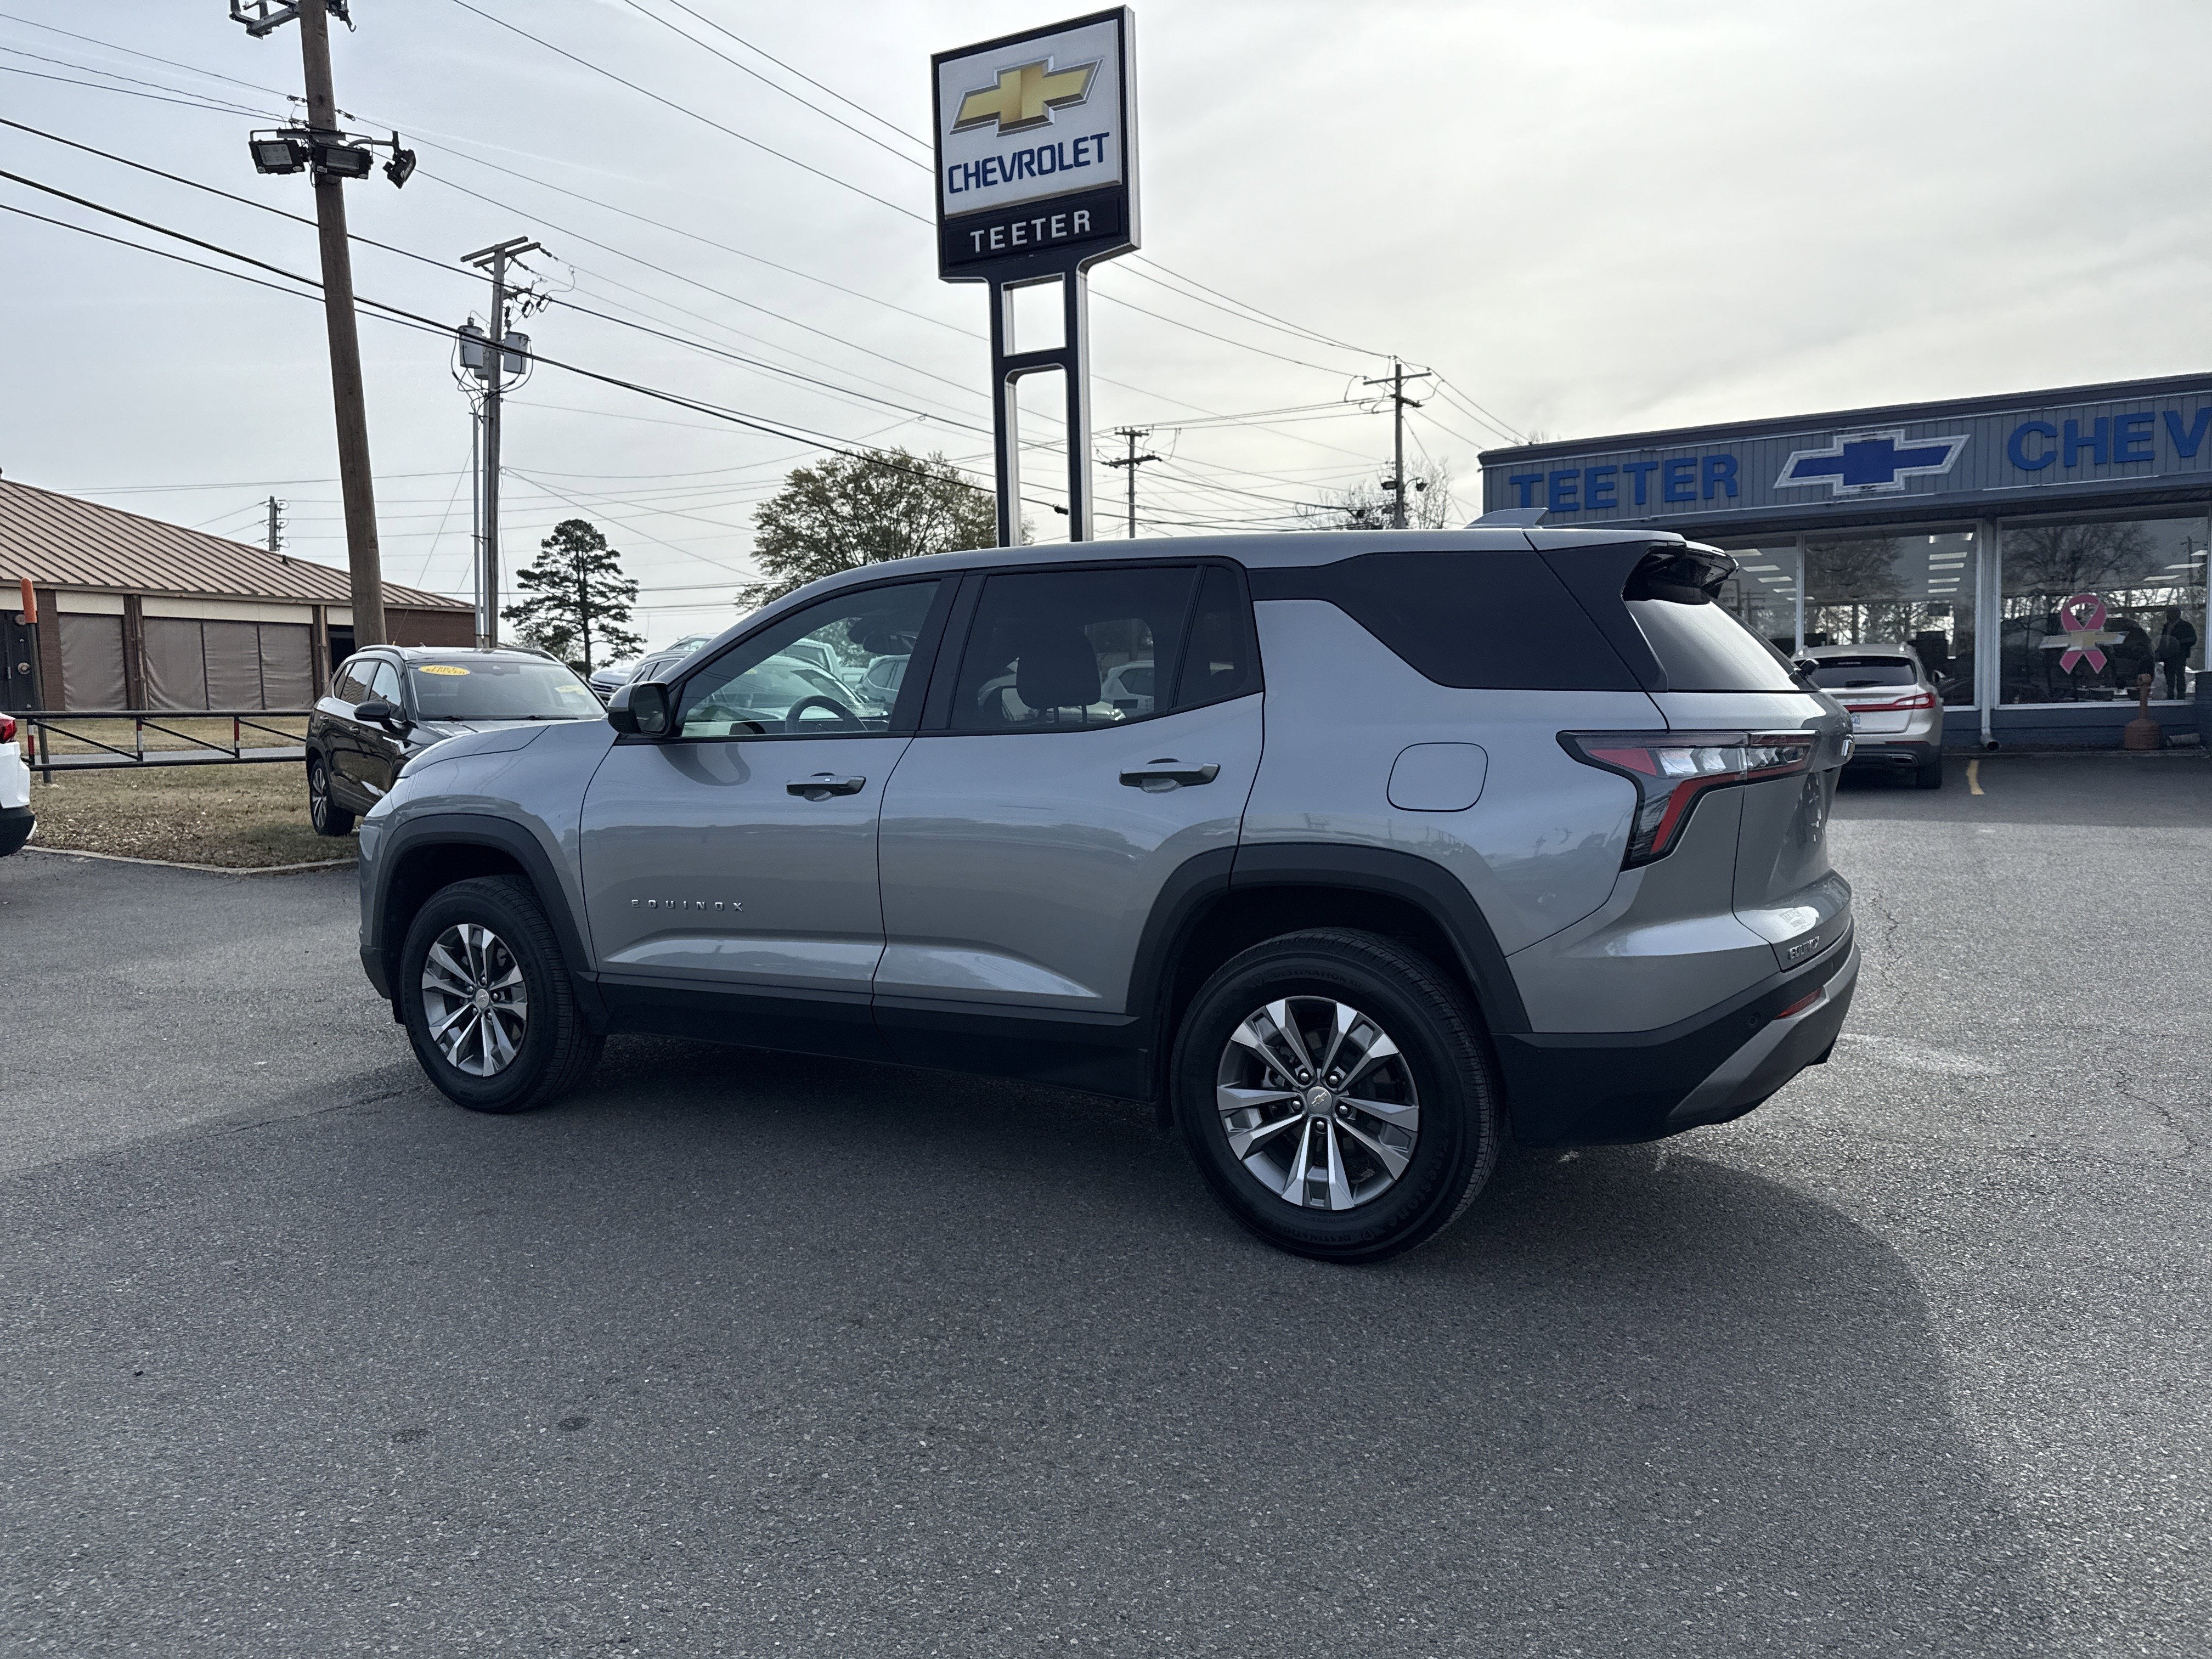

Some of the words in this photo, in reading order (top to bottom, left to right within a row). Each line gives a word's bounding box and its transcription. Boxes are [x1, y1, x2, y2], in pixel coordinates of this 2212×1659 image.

[949, 132, 1109, 194] CHEVROLET
[969, 210, 1091, 253] TEETER
[1510, 454, 1739, 512] TEETER
[631, 899, 743, 911] EQUINOX
